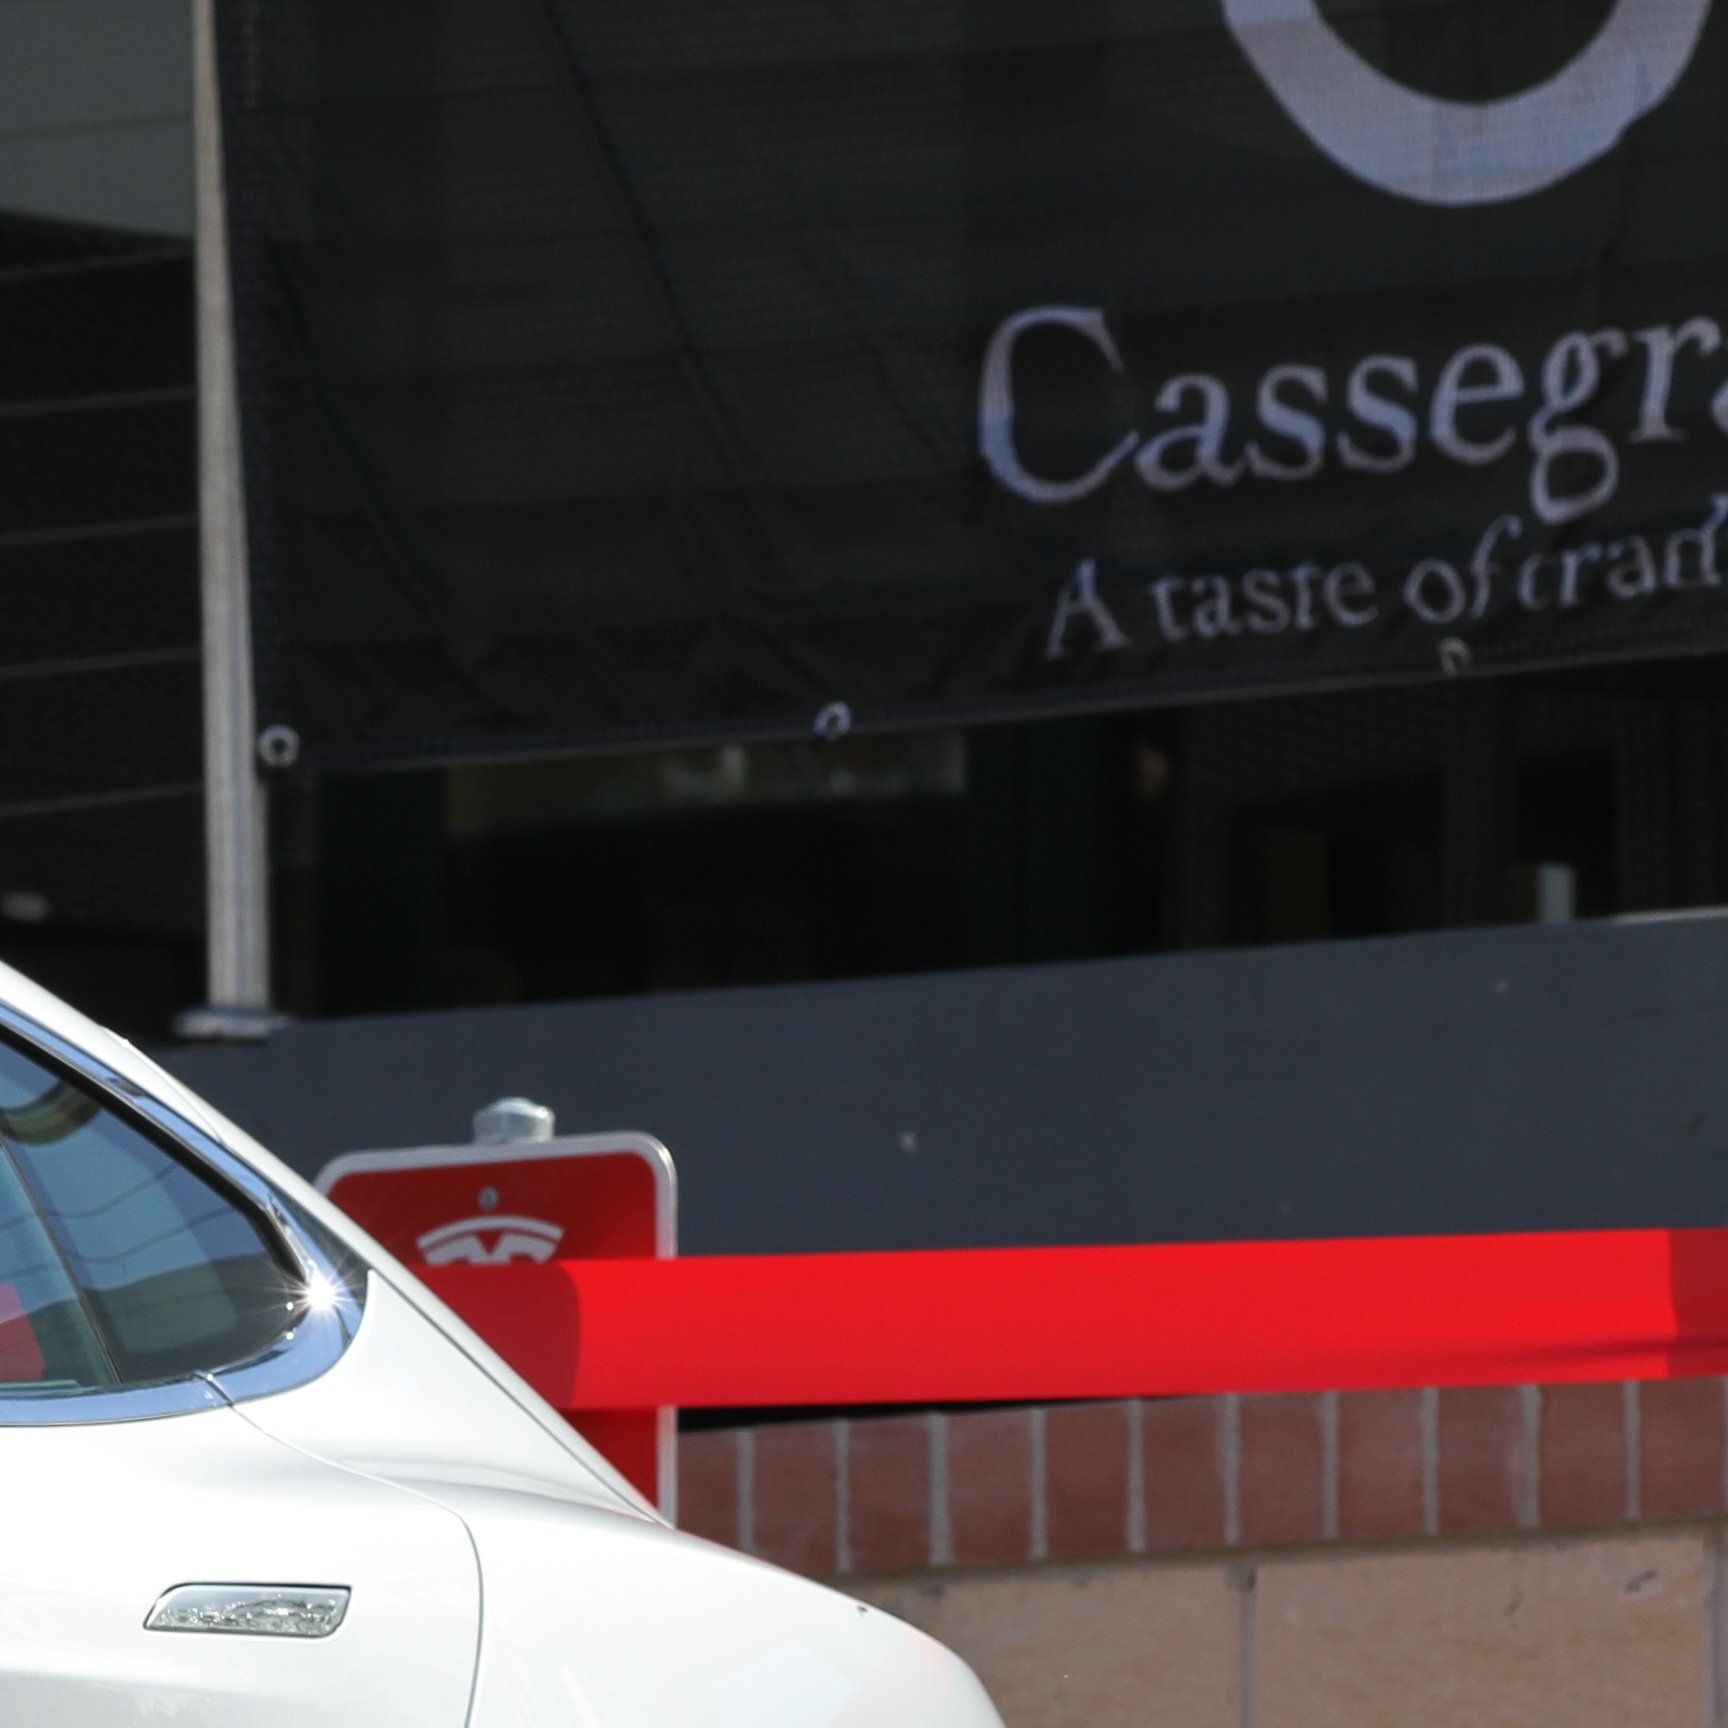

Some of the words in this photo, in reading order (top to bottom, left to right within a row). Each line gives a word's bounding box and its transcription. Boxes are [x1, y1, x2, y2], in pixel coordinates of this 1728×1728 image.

[1043, 556, 1127, 662] A
[1148, 560, 1379, 643] taste
[1403, 514, 1522, 624] of
